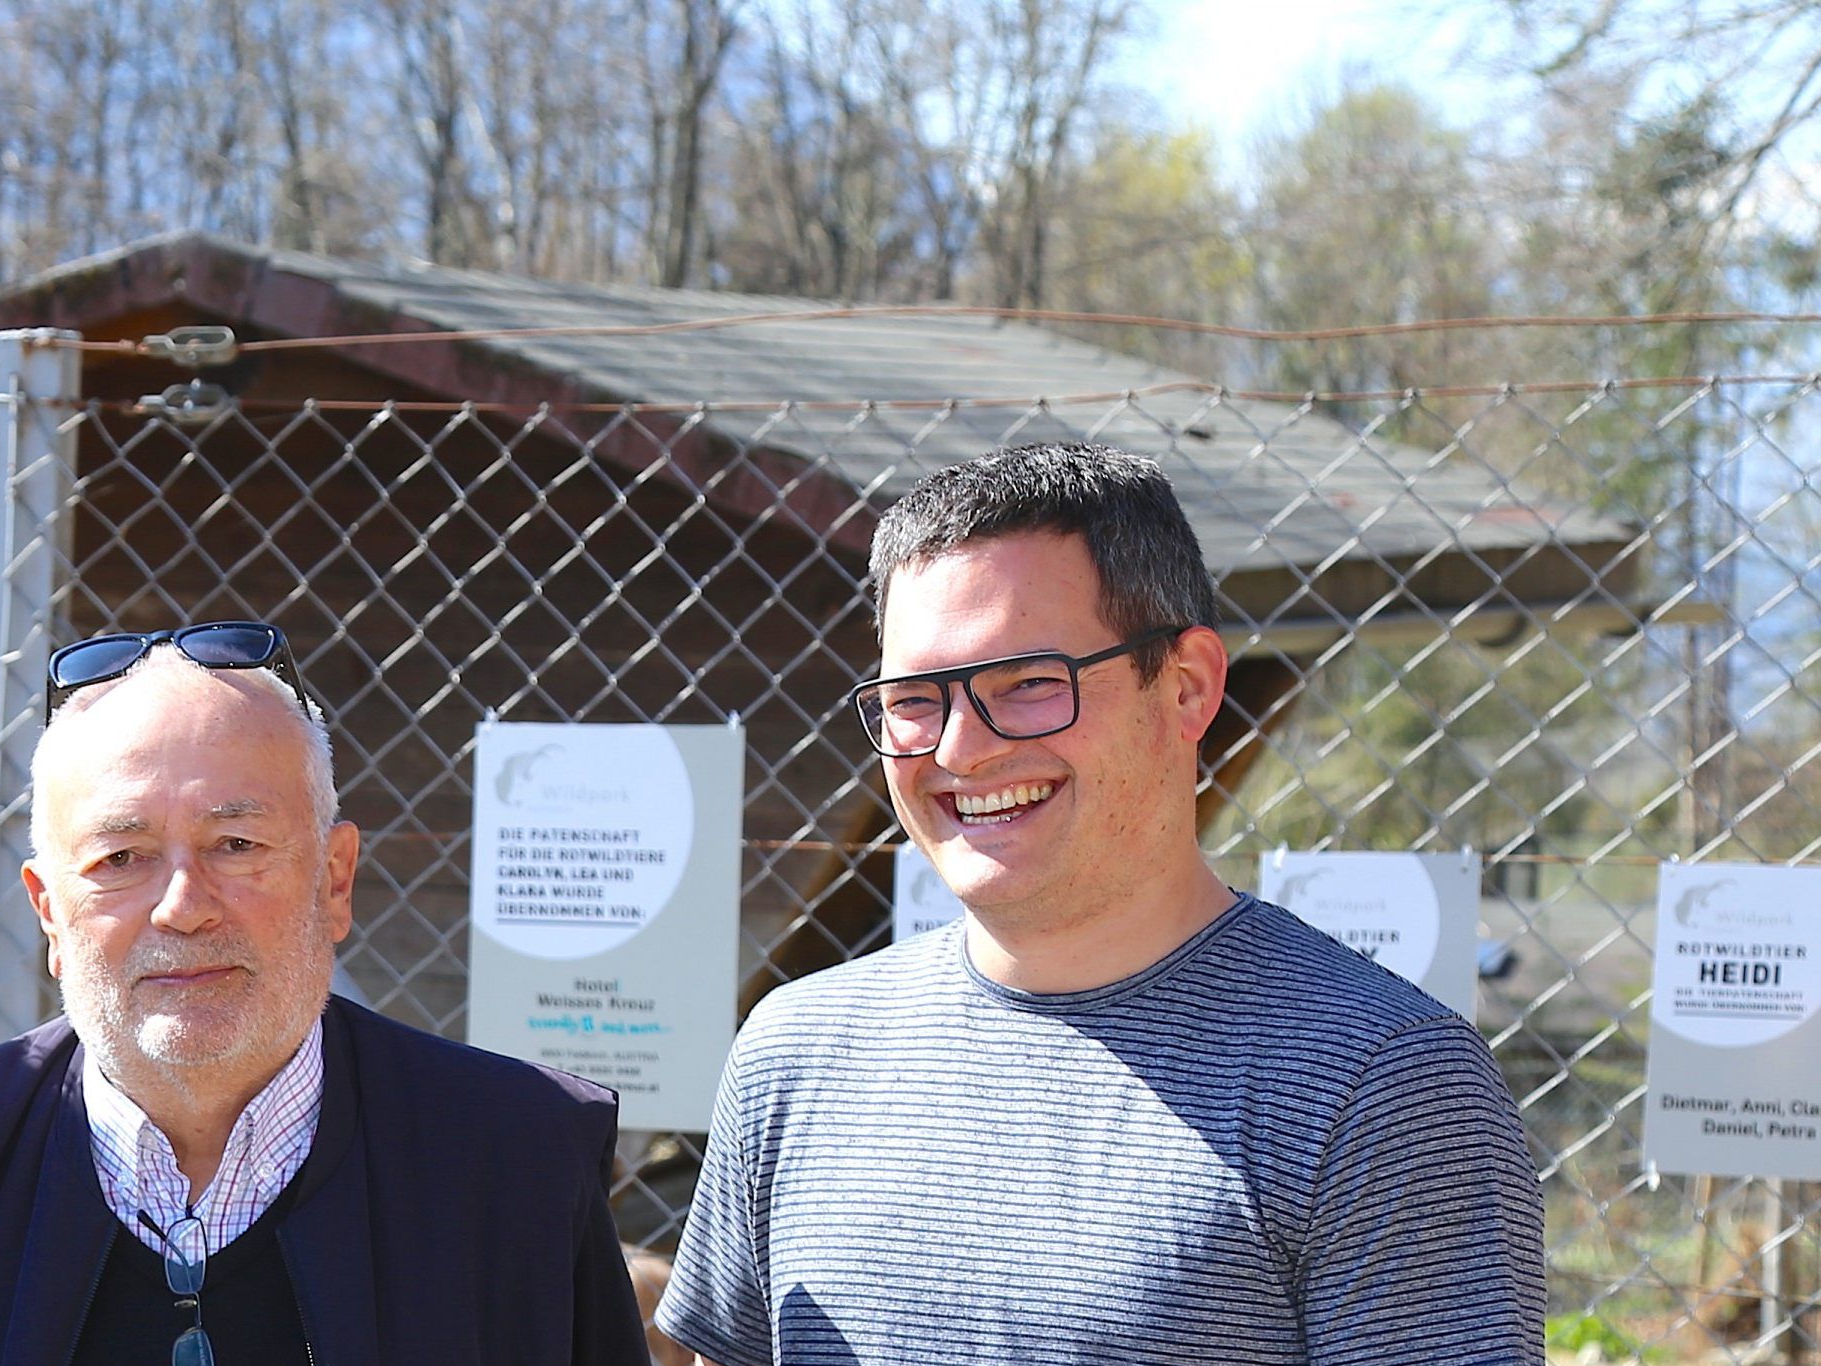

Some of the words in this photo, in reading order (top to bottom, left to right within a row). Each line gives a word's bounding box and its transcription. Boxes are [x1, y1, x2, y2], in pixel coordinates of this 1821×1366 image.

[498, 827, 523, 841] DIE
[531, 827, 641, 843] PATENSCHAFT
[498, 844, 526, 860] FÜR
[532, 847, 554, 861] DIE
[559, 847, 666, 863] ROTWILDTIERE
[572, 866, 599, 880] LEA
[604, 866, 634, 881] UND
[497, 884, 546, 898] KLARA
[554, 885, 604, 899] WURDE
[1678, 942, 1808, 958] ROTWILDTIER
[1700, 961, 1781, 985] HEIDI
[574, 977, 618, 992] Hotel
[537, 993, 603, 1010] Weisses
[610, 996, 656, 1012] Kreuz
[1662, 1094, 1737, 1115] Dietmar,
[1742, 1099, 1786, 1117] Anni,
[1790, 1101, 1821, 1115] Cla
[1702, 1119, 1763, 1138] Daniel,
[1768, 1121, 1817, 1138] Petra
